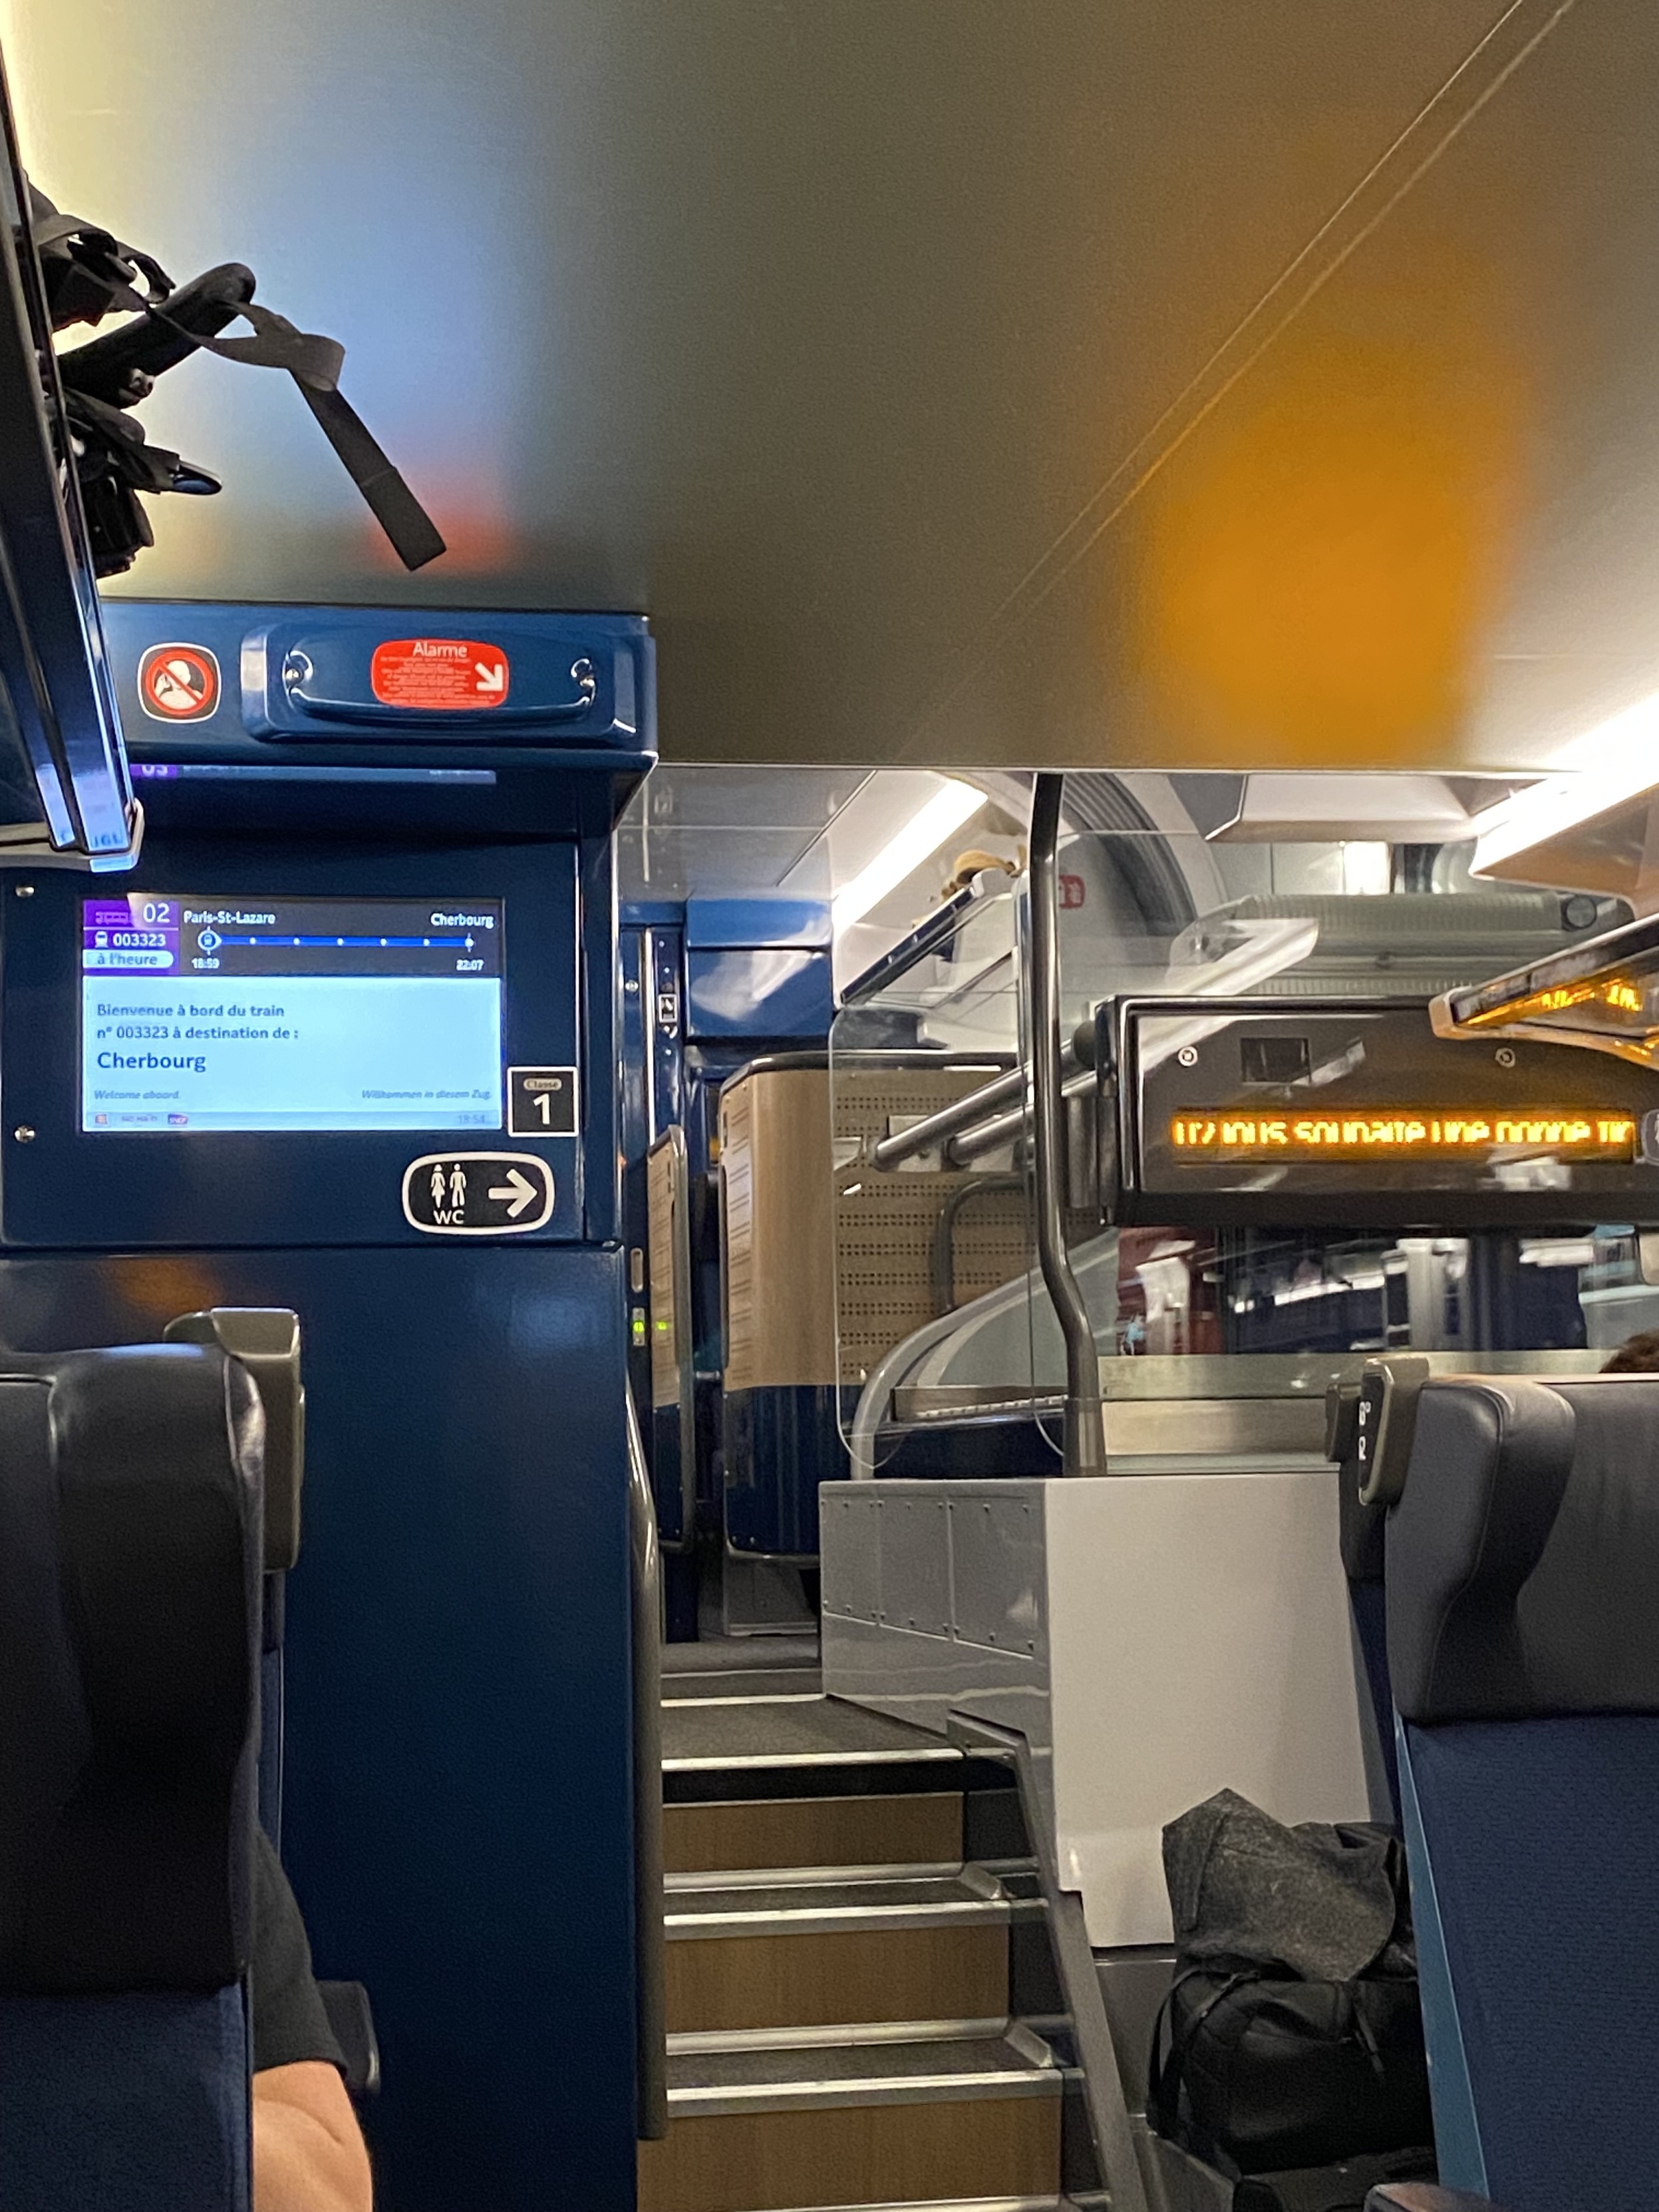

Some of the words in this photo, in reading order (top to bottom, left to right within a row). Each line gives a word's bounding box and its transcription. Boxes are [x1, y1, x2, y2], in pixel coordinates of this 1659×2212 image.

[412, 641, 468, 657] Alarme
[142, 903, 170, 923] 02
[184, 910, 275, 925] Paris-St-Lazare
[430, 913, 494, 929] Cherbourg
[112, 933, 166, 947] 003323
[97, 953, 105, 965] à
[109, 951, 158, 965] l'heure
[97, 1005, 173, 1017] Bienvenue
[177, 1005, 186, 1017] à
[190, 1005, 224, 1017] bord
[227, 1005, 246, 1017] du
[249, 1005, 285, 1017] train
[116, 1027, 168, 1038] 003323
[173, 1027, 181, 1038] à
[185, 1027, 268, 1039] destination
[272, 1027, 290, 1039] de
[97, 1052, 206, 1072] Cherbourg
[94, 1090, 140, 1100] Welcome
[362, 1090, 422, 1099] Willkommen
[436, 1090, 470, 1099] diesem
[533, 1093, 551, 1124] 1
[433, 1209, 465, 1224] WC
